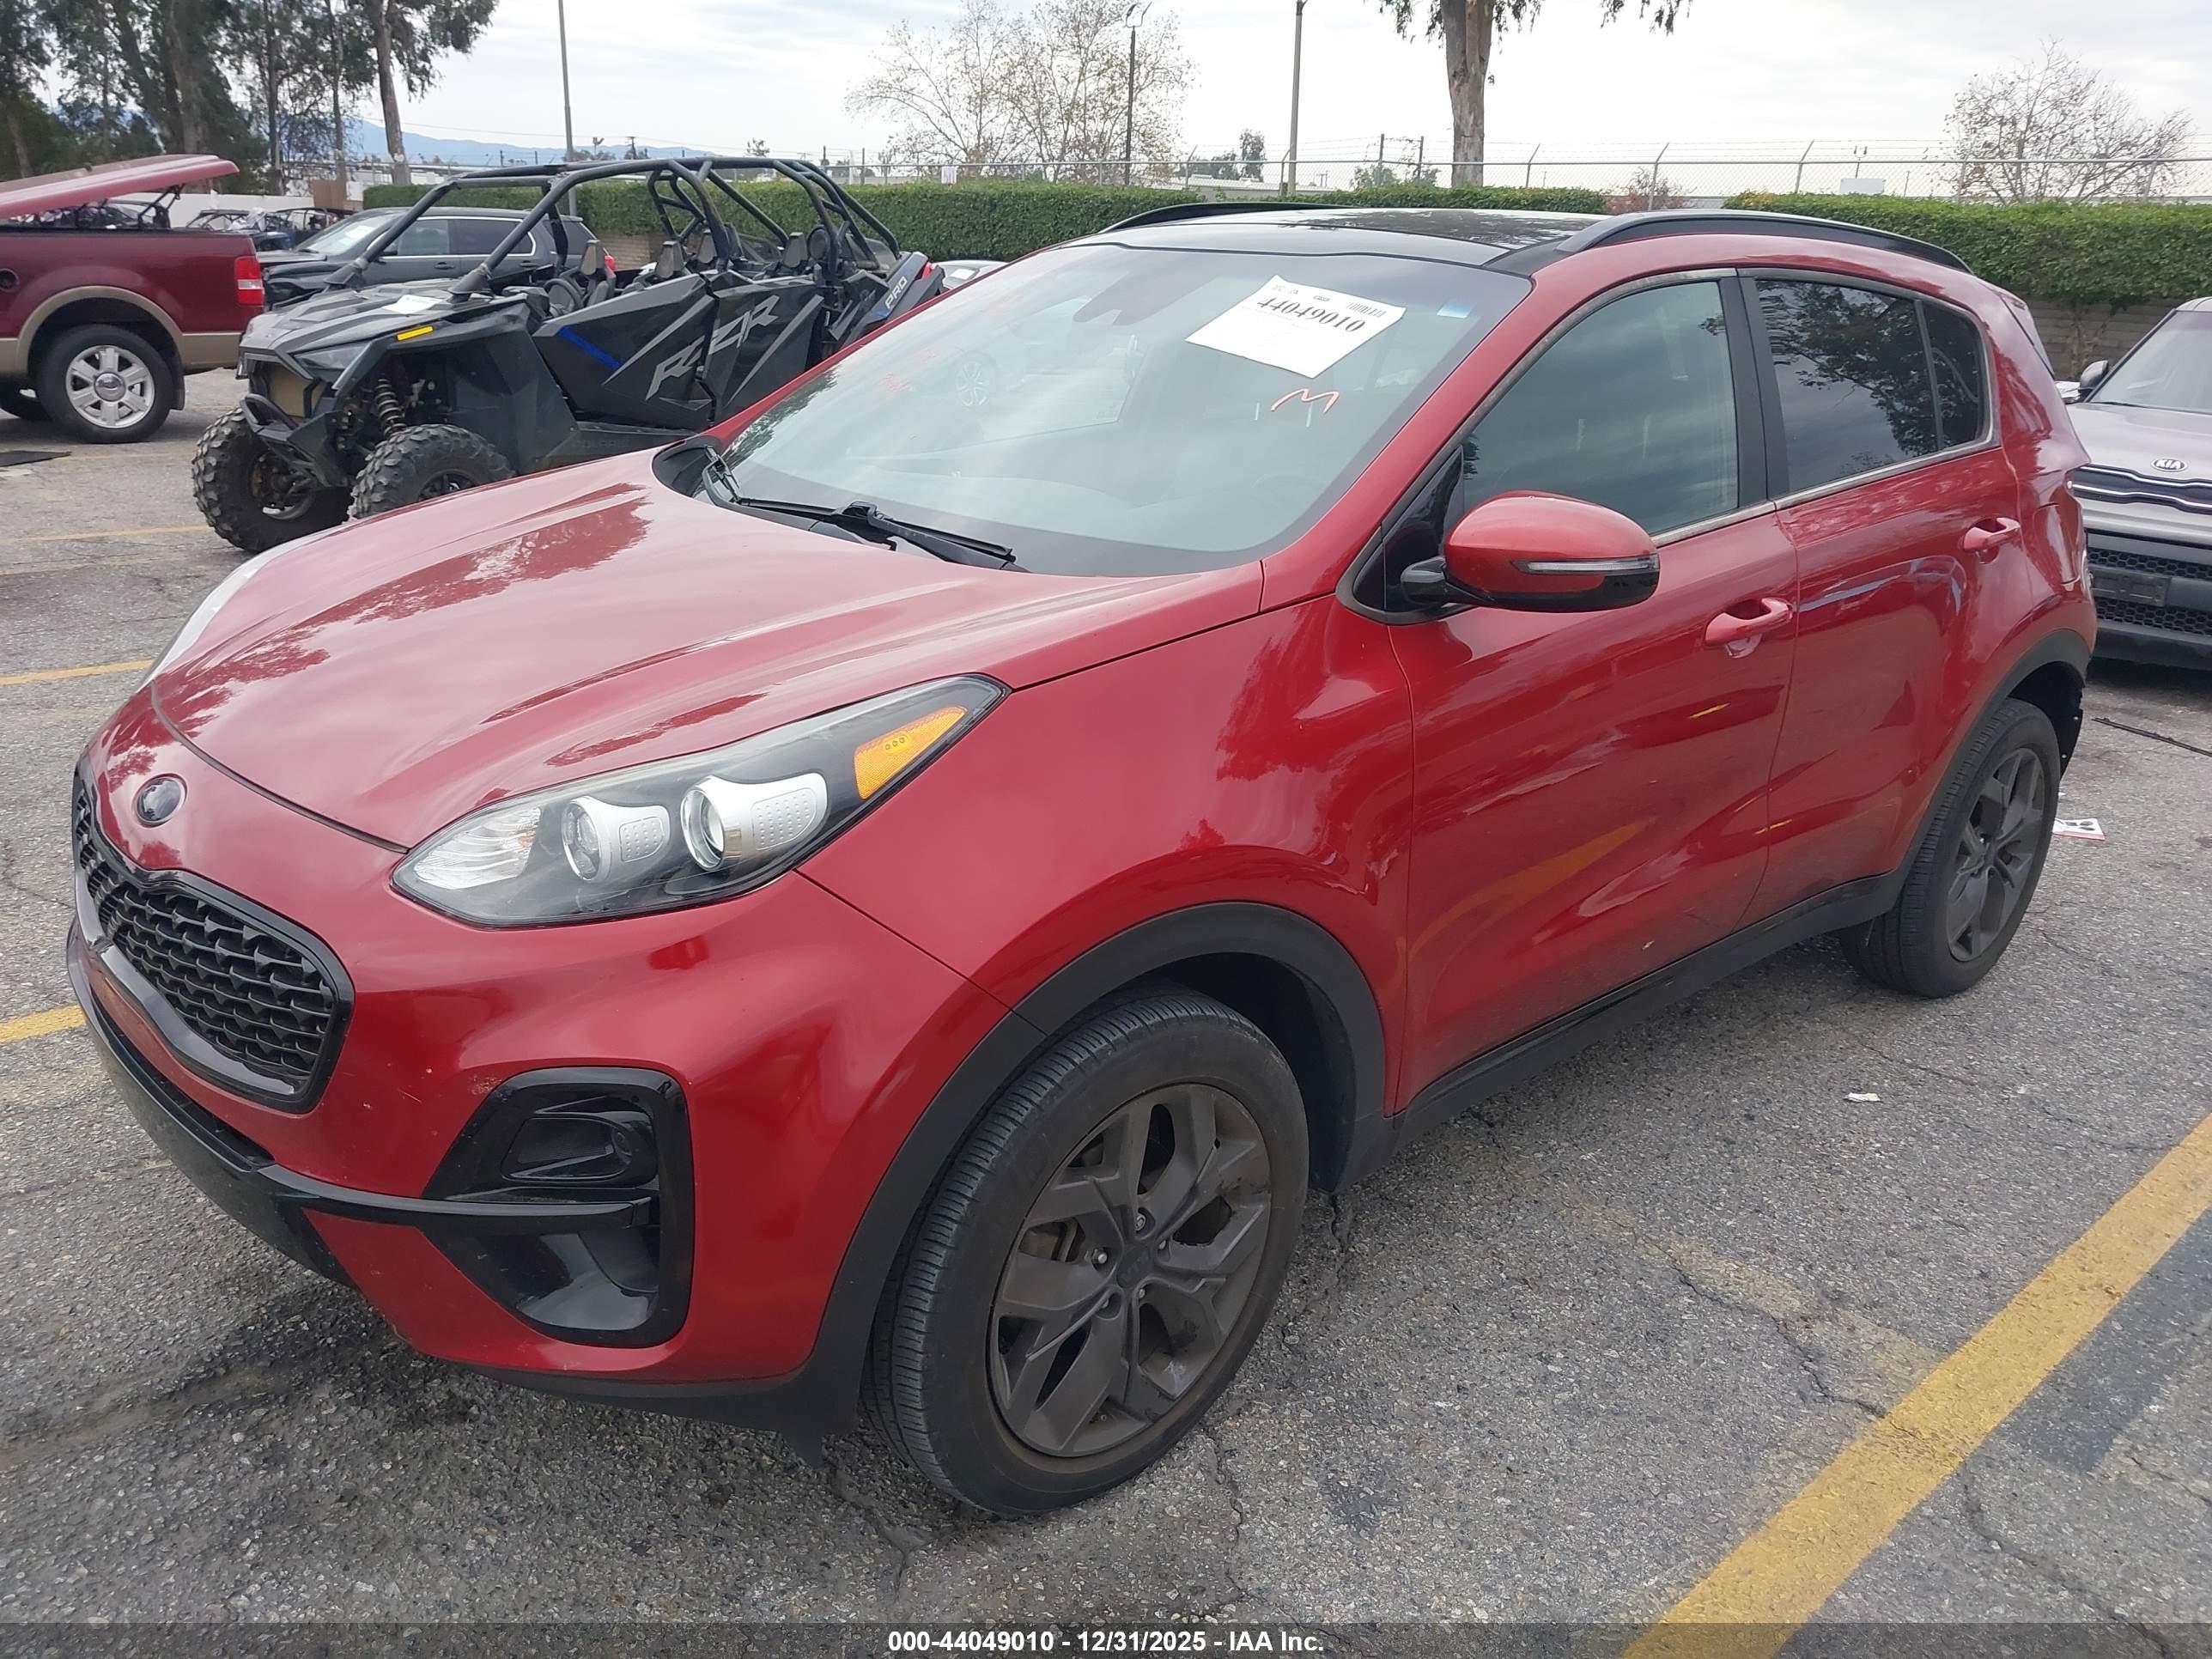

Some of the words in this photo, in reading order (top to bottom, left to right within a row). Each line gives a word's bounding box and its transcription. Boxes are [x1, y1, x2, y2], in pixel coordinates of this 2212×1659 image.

[884, 276, 908, 309] PRO
[1257, 297, 1365, 332] 44049010
[2155, 459, 2181, 469] KIA
